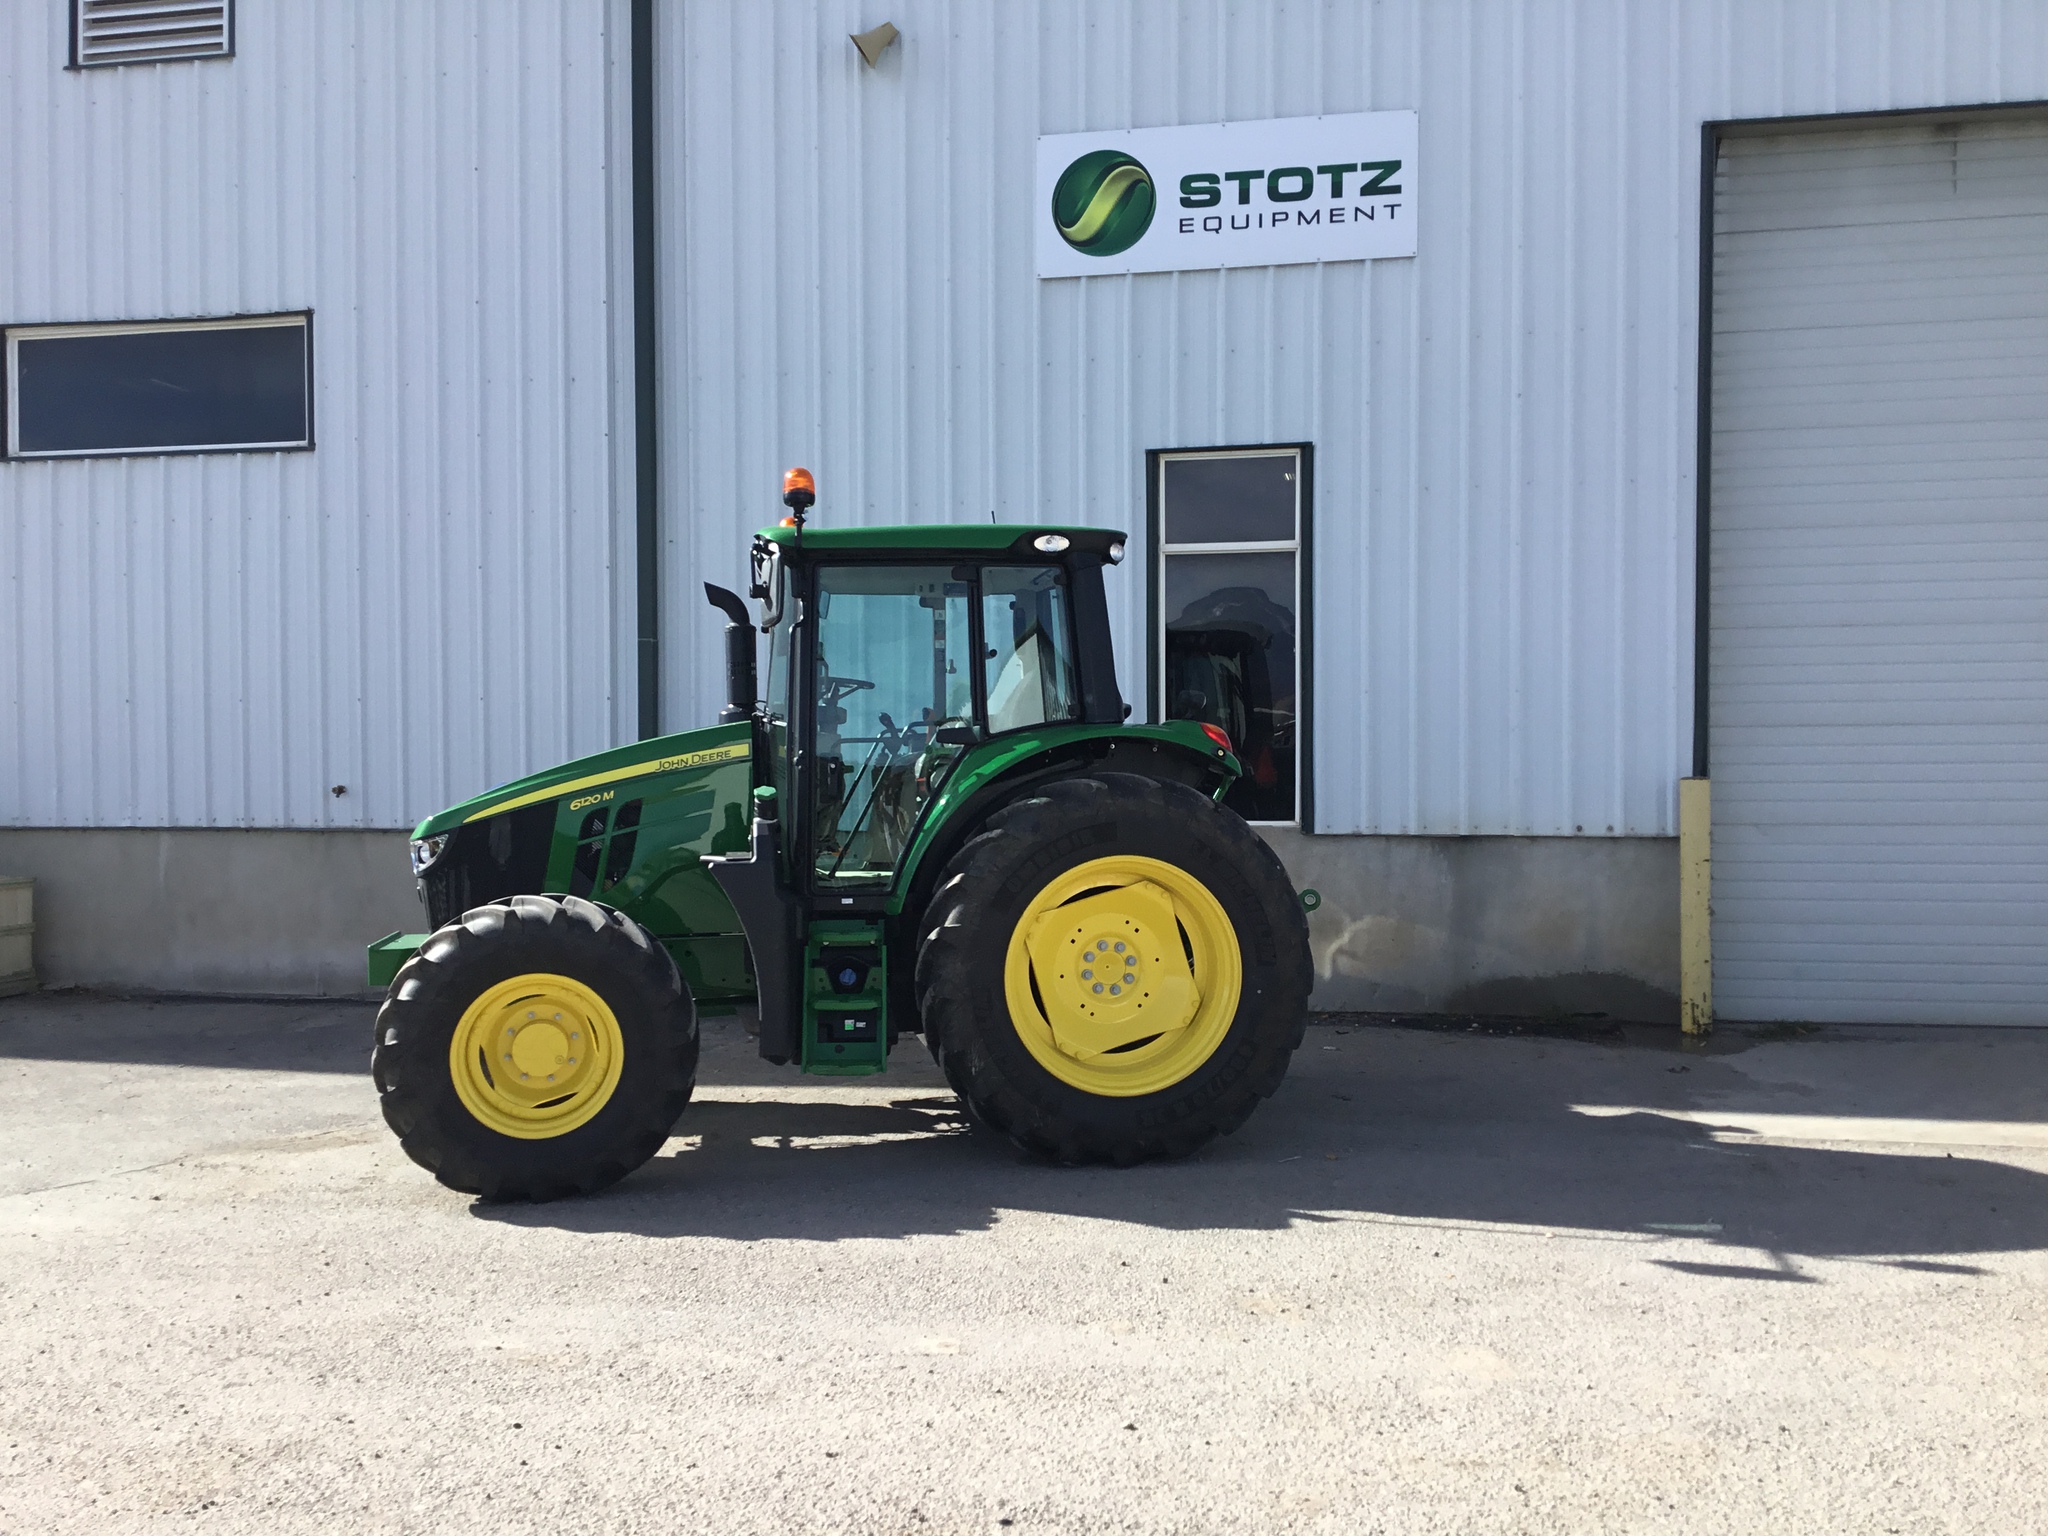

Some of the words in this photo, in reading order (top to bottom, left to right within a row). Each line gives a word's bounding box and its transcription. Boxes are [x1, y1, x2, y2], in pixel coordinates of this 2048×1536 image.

[1179, 159, 1402, 208] STOTZ
[1179, 204, 1402, 234] EQUIPMENT
[655, 758, 689, 772] JOHN
[691, 750, 732, 764] DEERE
